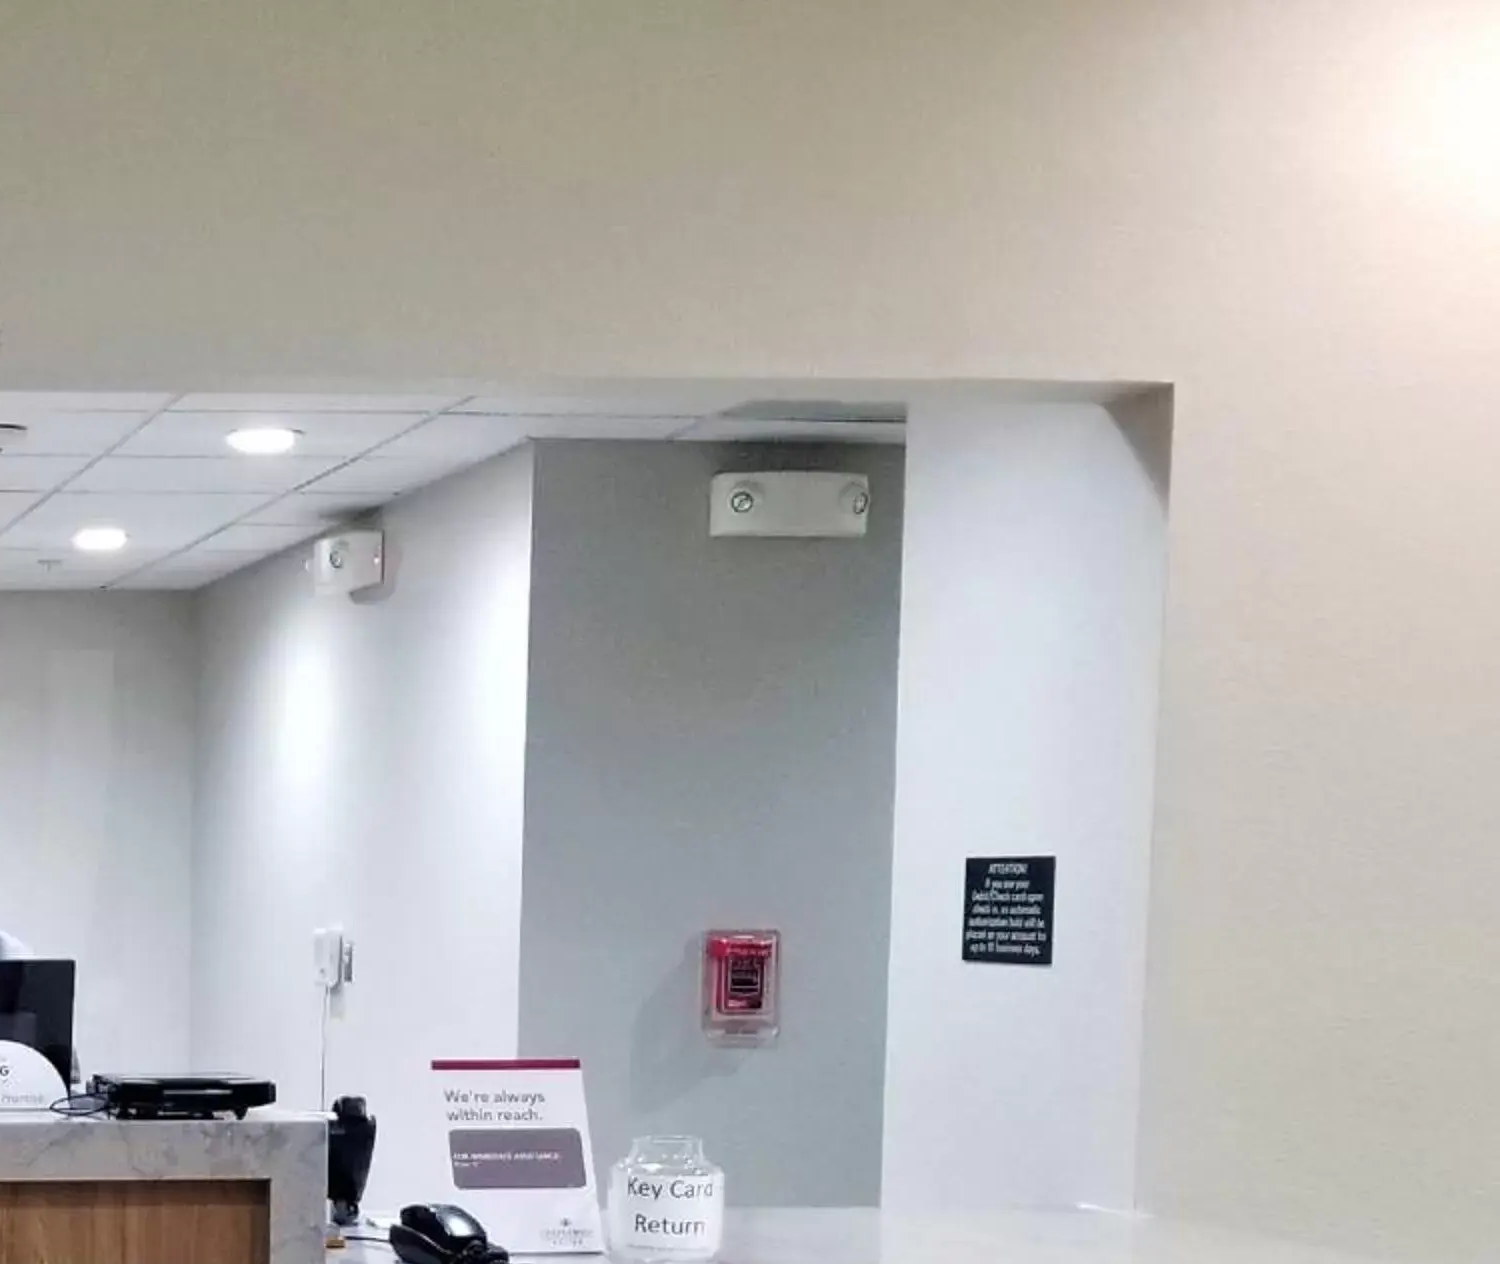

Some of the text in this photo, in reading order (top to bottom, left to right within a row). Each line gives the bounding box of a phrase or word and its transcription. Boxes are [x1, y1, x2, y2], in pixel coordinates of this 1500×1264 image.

[444, 1089, 545, 1108] We're always
[446, 1107, 544, 1122] within reach.
[627, 1176, 714, 1200] Key Card
[634, 1213, 706, 1237] Return
